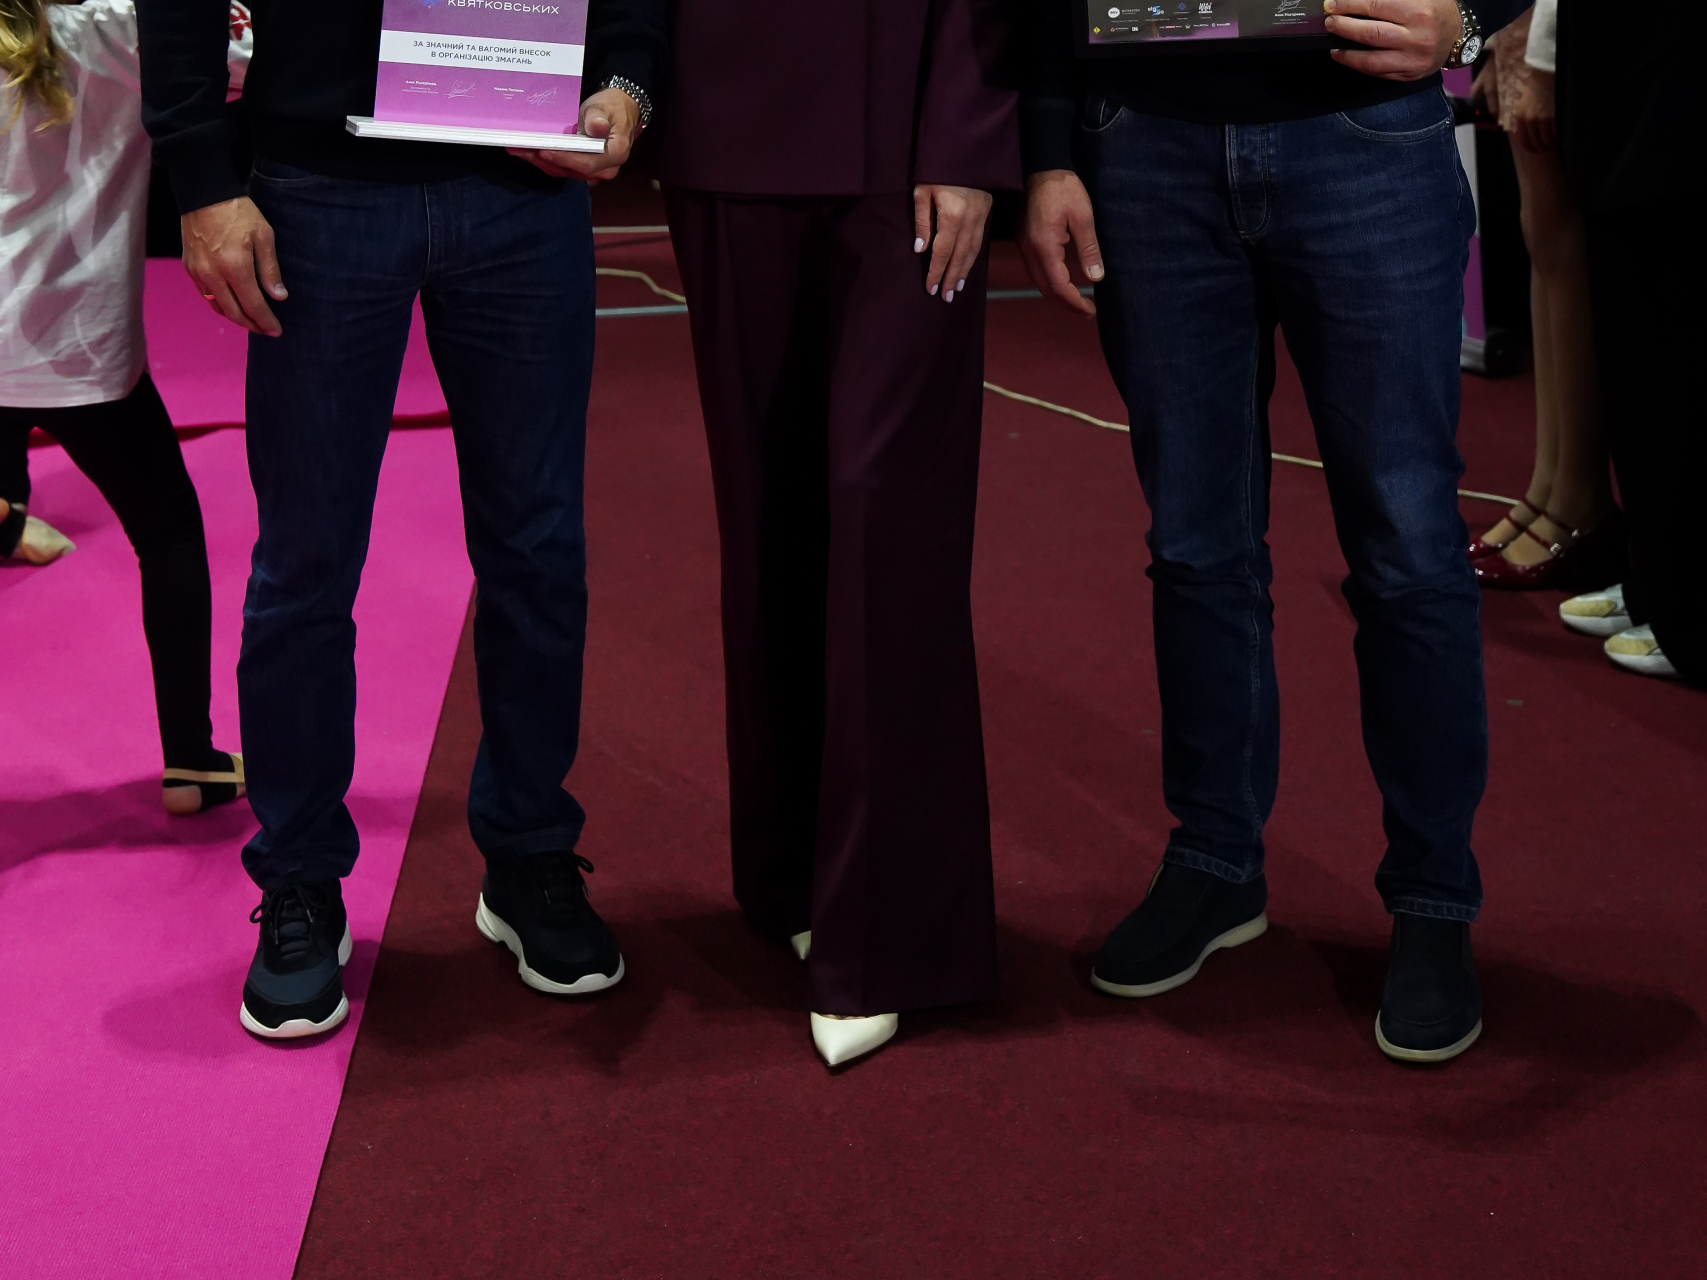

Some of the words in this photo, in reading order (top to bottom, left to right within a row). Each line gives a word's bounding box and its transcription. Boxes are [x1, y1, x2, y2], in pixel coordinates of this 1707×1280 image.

[413, 40, 424, 48] ЗА
[425, 41, 464, 51] ЗНАЧНИЙ
[466, 44, 477, 52] ТА
[478, 45, 518, 55] ВАГОМИЙ
[519, 48, 552, 57] ВНЕСОК
[438, 51, 494, 62] ОРГАНІЗАЦІЮ
[495, 56, 533, 65] ЗМАГАНЬ
